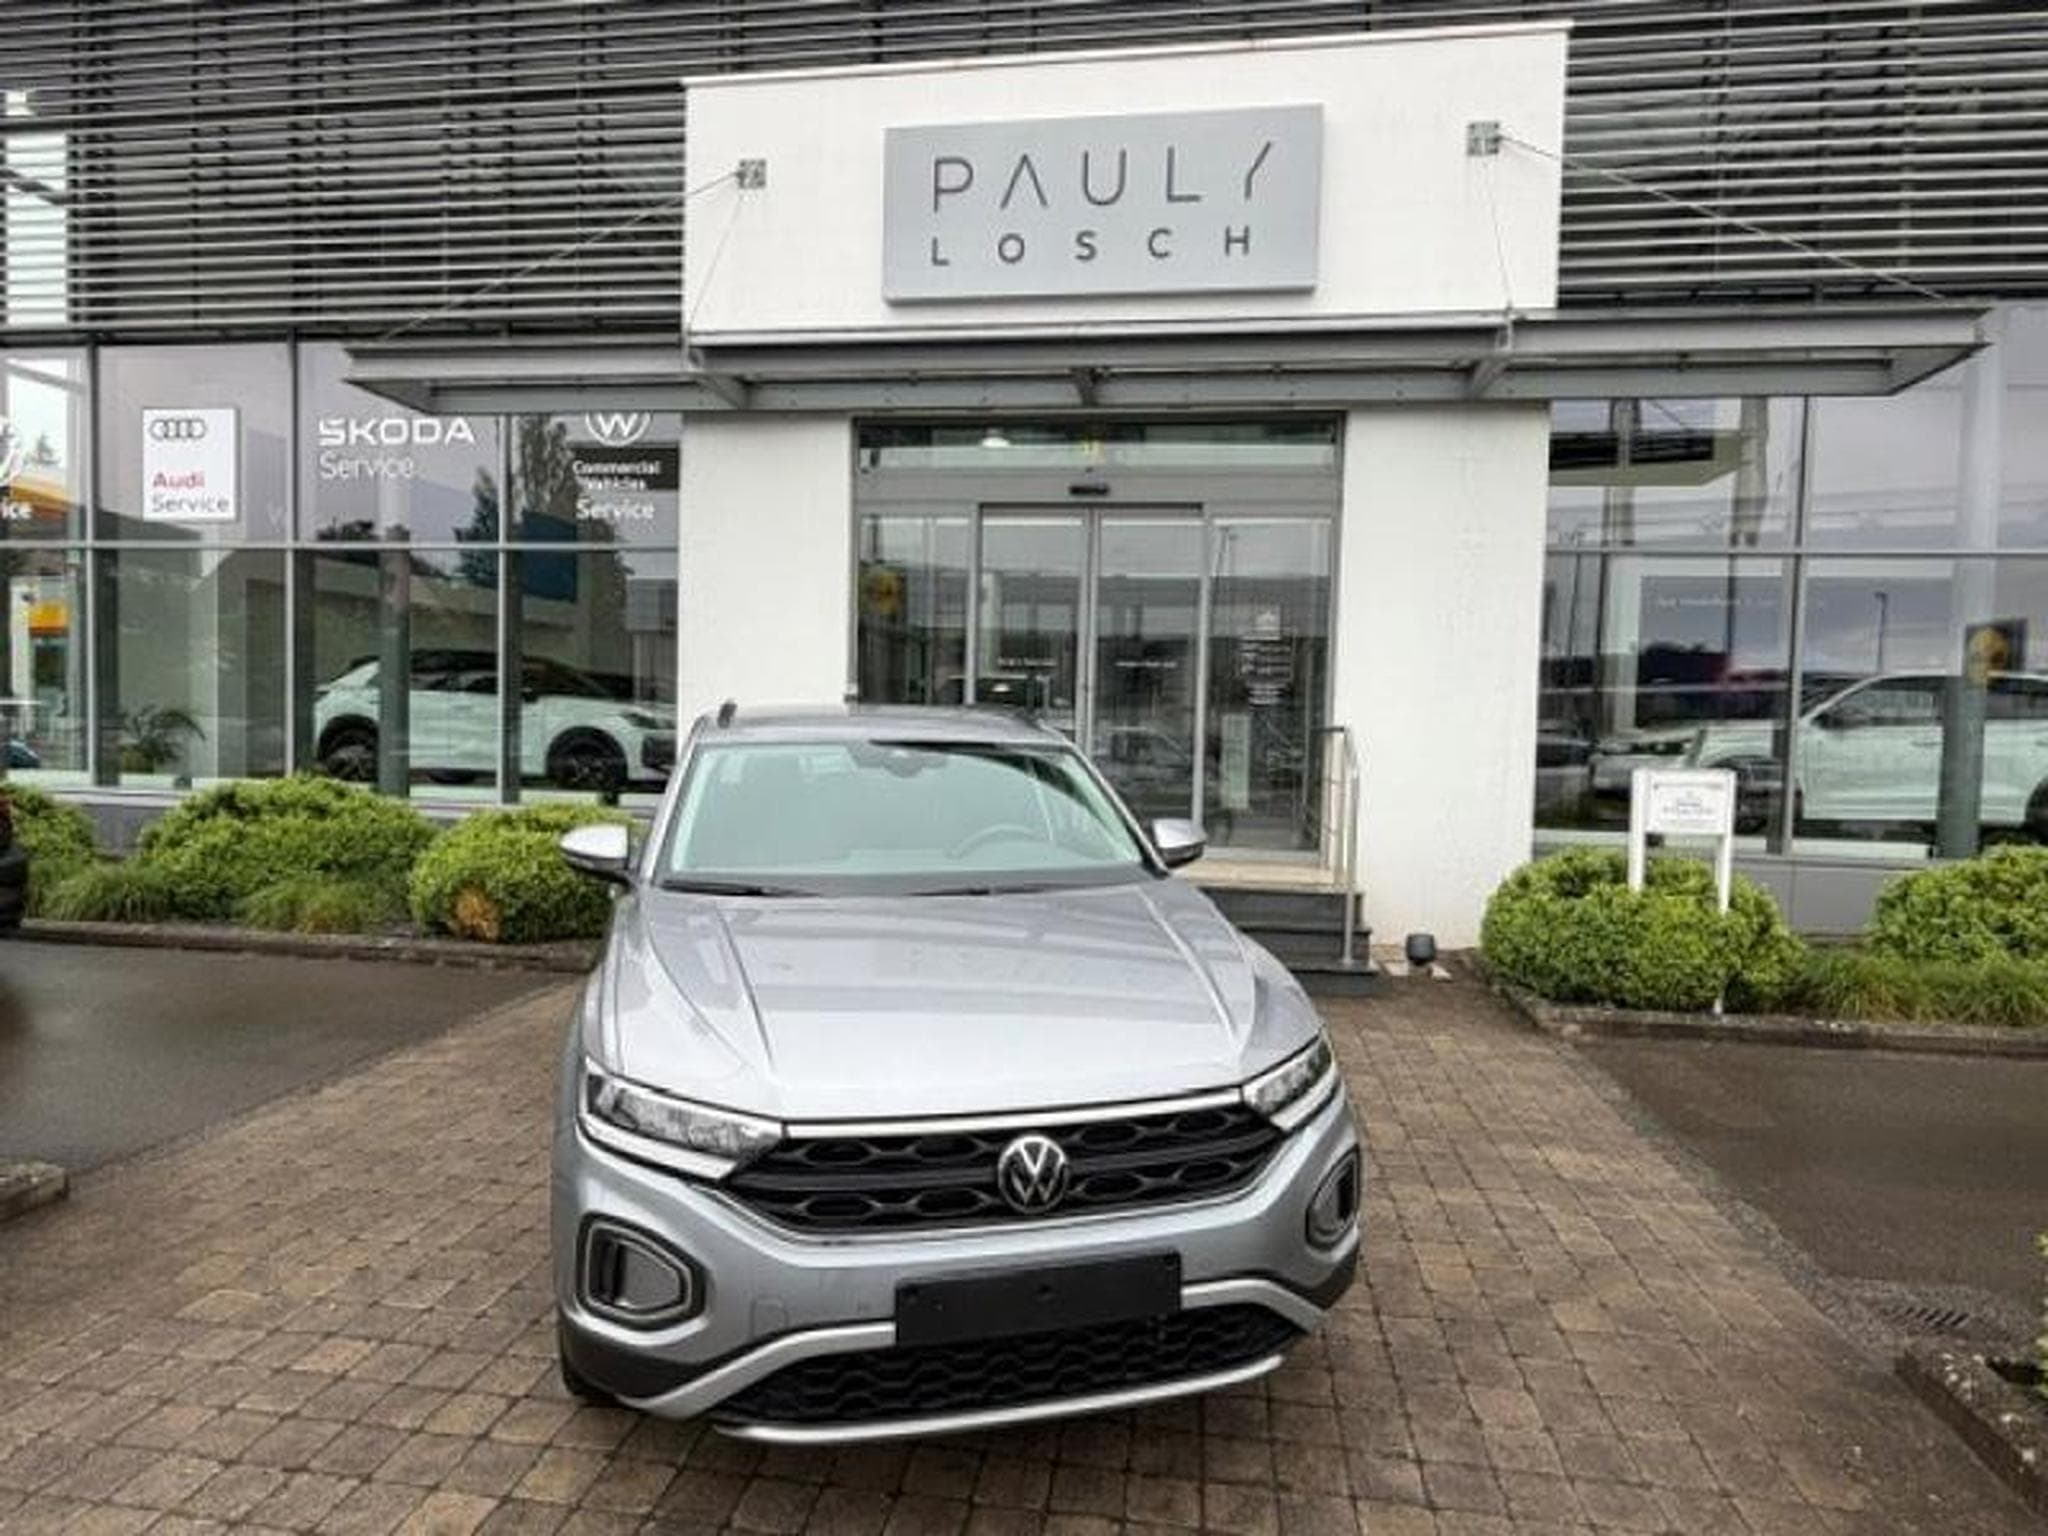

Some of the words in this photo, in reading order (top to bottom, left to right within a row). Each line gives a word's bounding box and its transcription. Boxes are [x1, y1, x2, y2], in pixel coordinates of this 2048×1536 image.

[933, 141, 1272, 212] PAULY
[931, 226, 1250, 266] LOSCH
[320, 451, 414, 479] Service
[572, 460, 660, 475] Commercial
[153, 470, 205, 489] Audi
[153, 495, 230, 512] Service
[576, 499, 654, 519] Service
